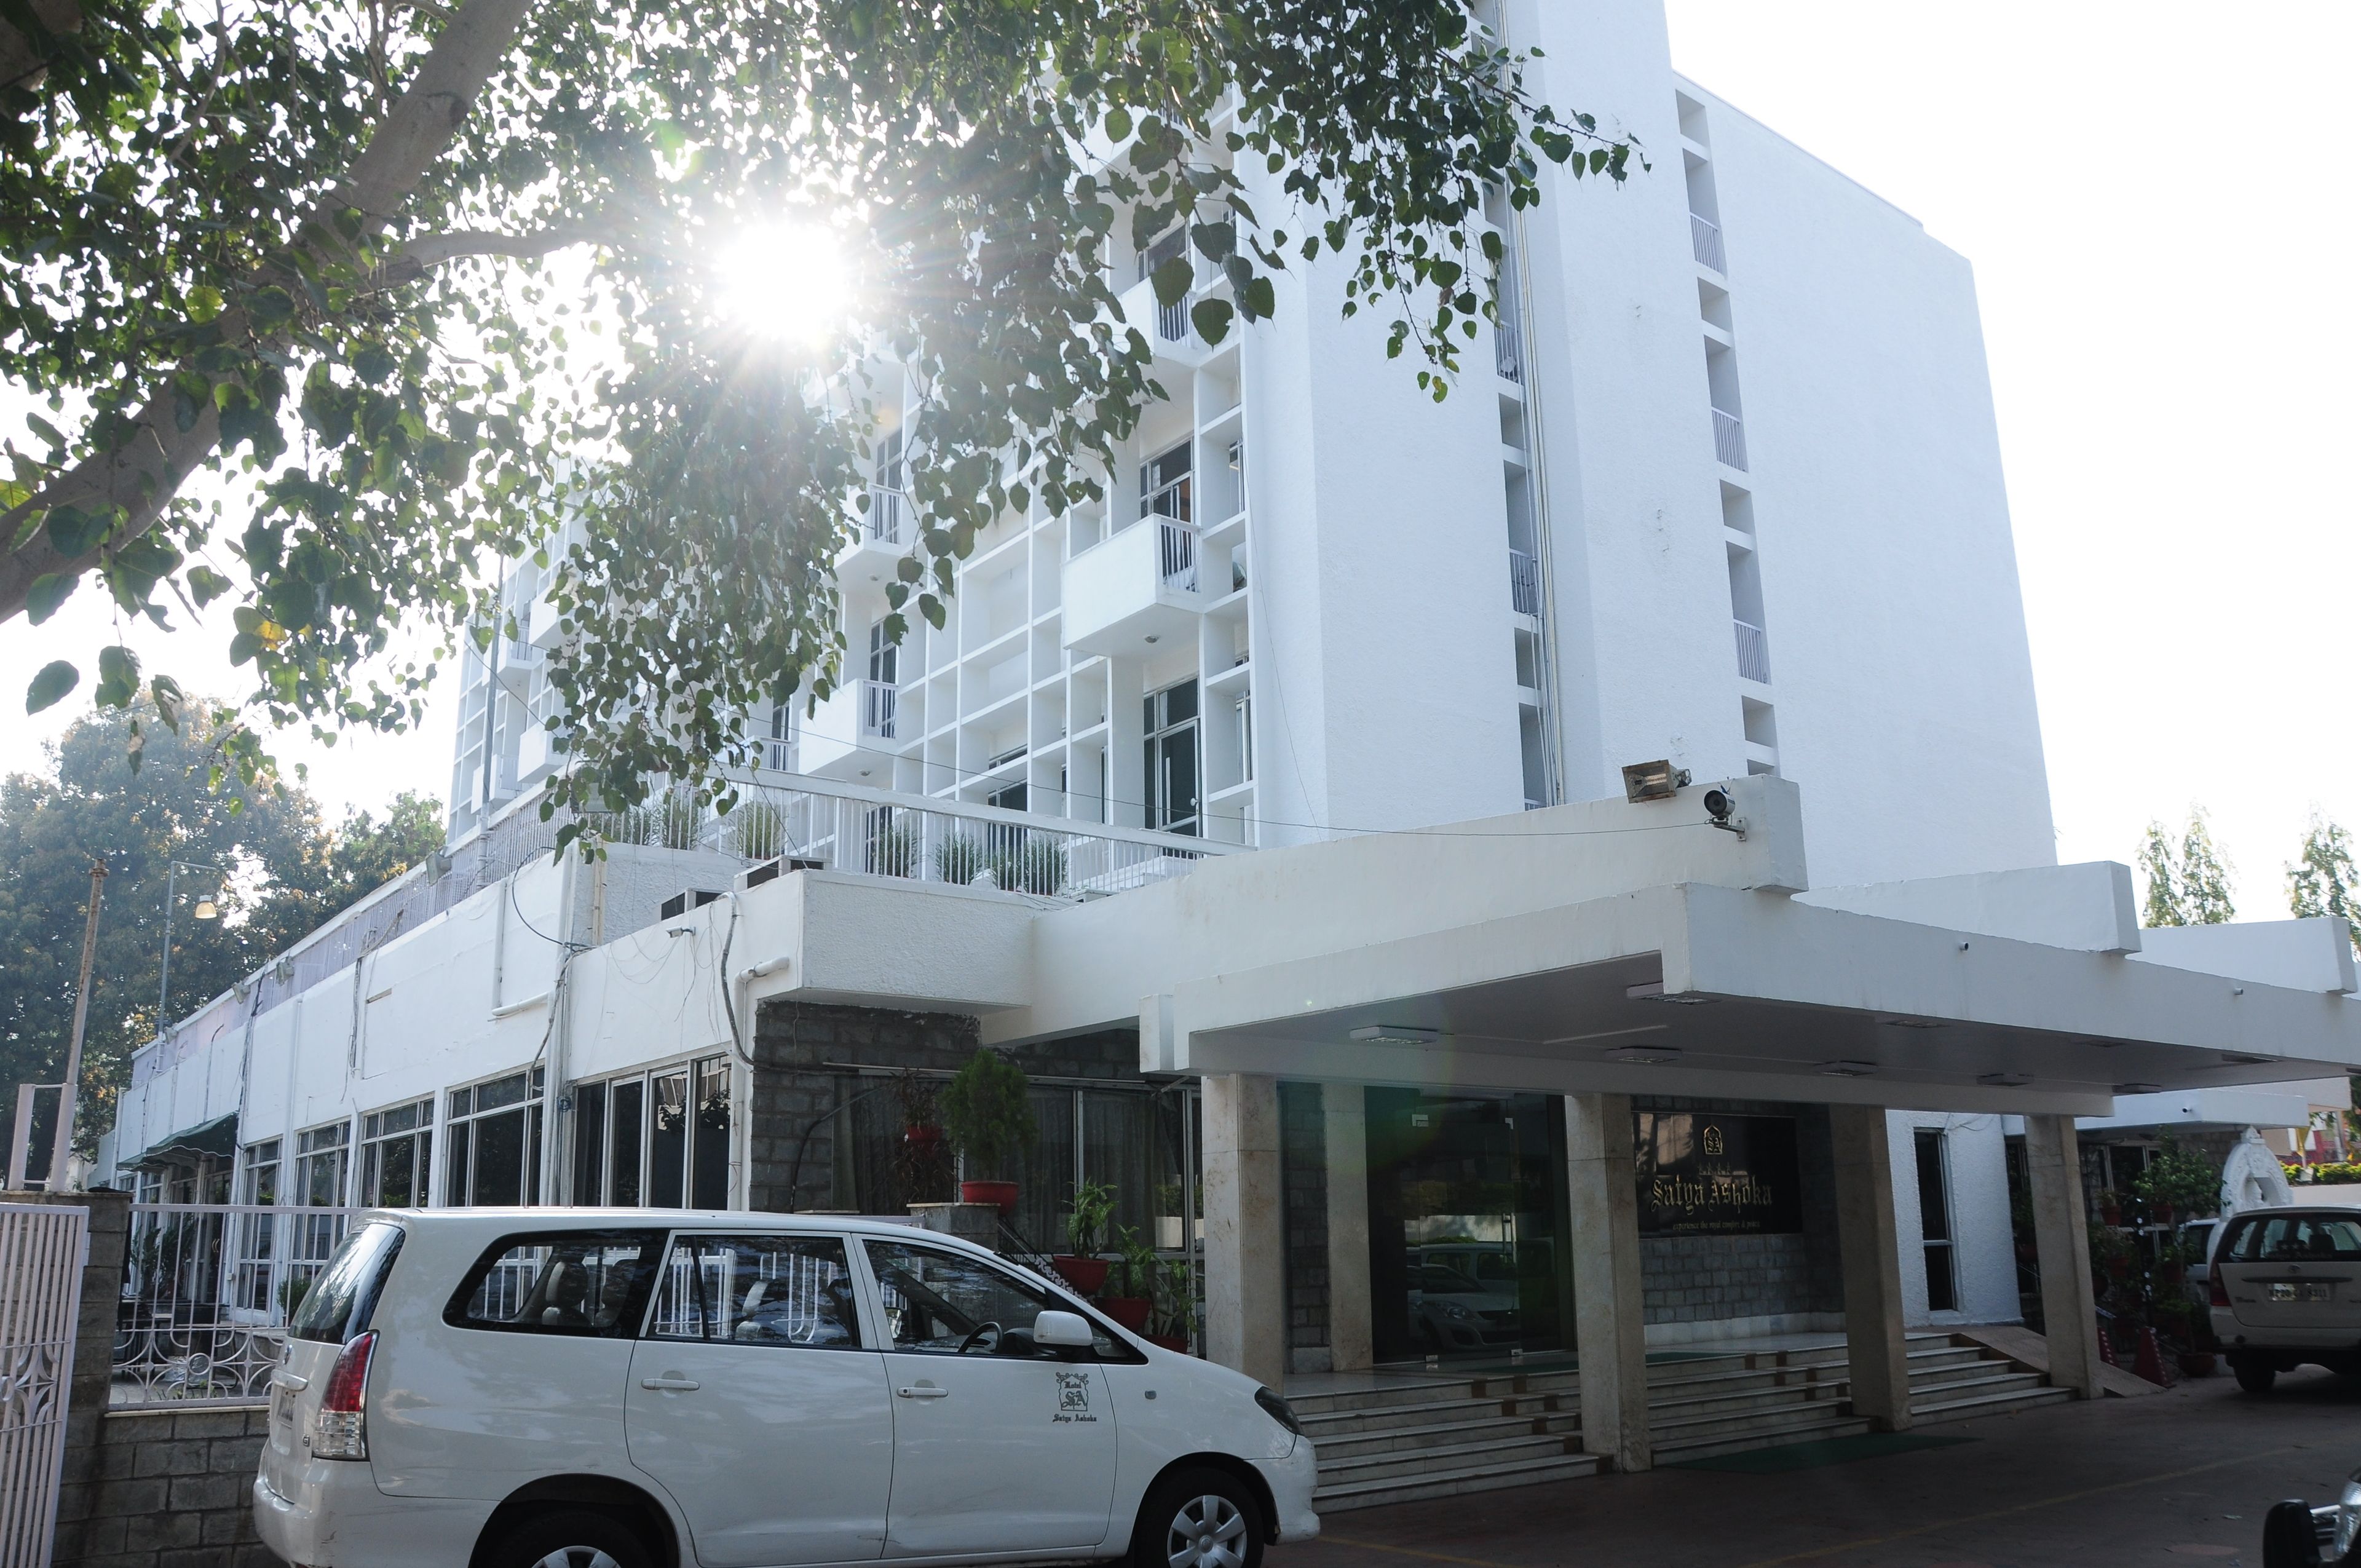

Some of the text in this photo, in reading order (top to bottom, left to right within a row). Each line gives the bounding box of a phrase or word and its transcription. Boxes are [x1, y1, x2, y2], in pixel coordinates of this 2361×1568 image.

[1651, 1174, 1773, 1216] Satya Ashoka
[1053, 1414, 1071, 1423] Satya
